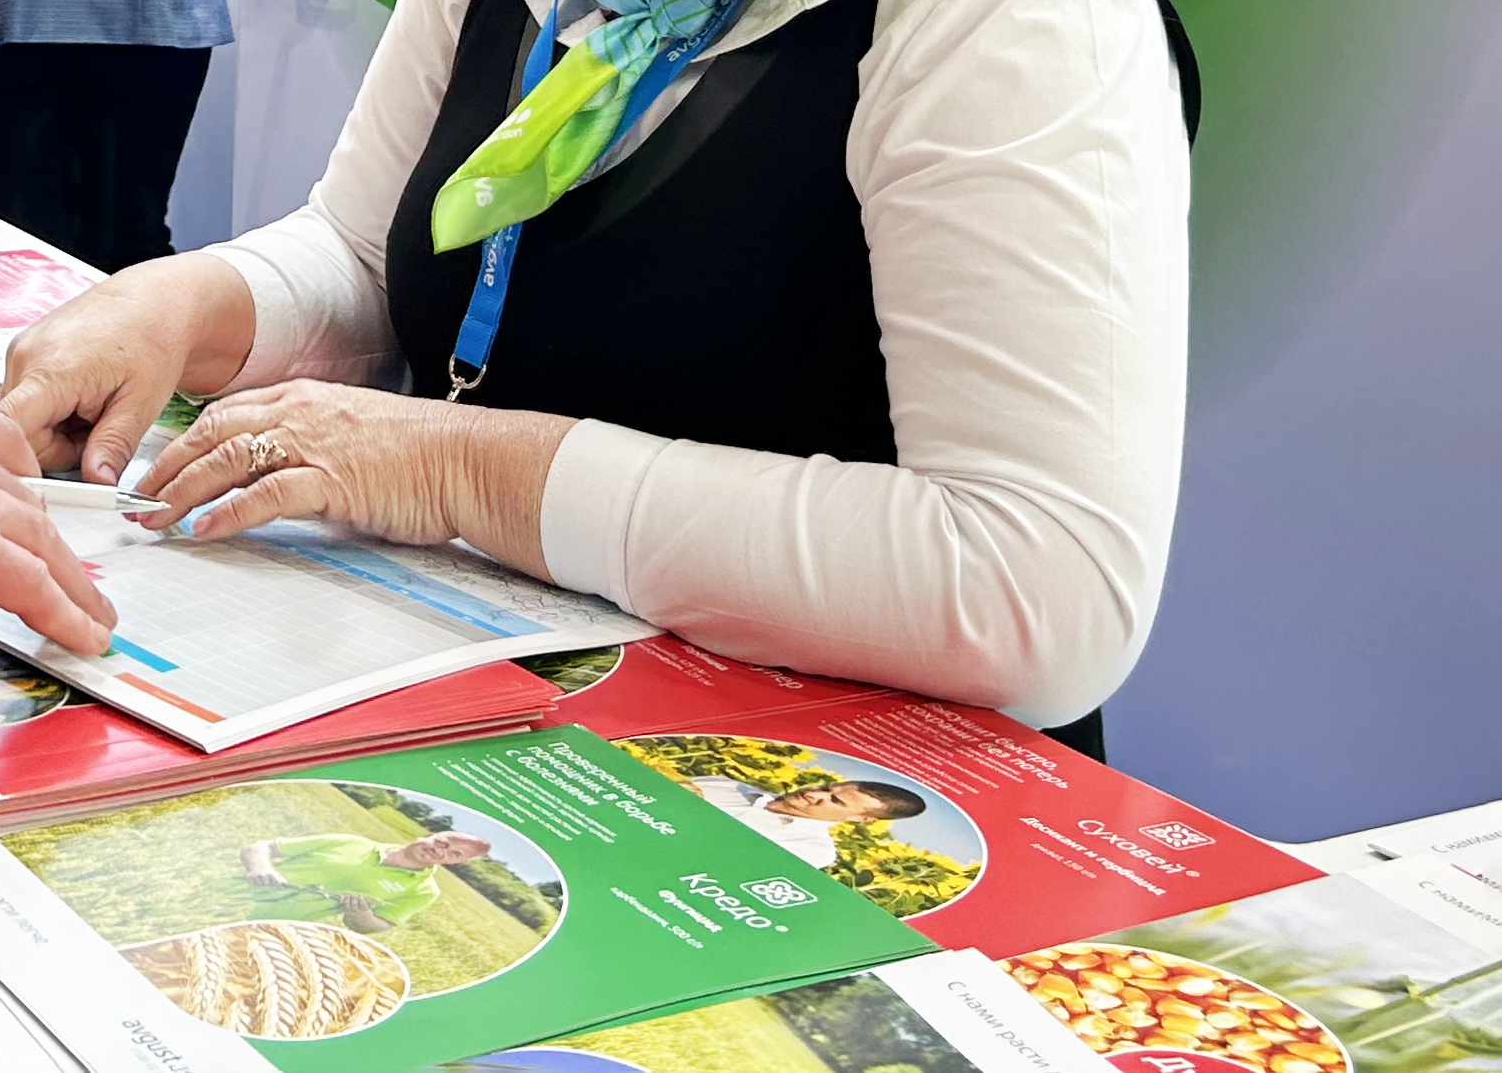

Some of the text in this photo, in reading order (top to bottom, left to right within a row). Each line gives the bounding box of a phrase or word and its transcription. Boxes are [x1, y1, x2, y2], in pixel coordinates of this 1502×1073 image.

[505, 749, 601, 806] с болезнями
[527, 745, 608, 794] помощник
[601, 793, 619, 802] в
[615, 800, 677, 836] борьбе
[548, 741, 658, 805] Проверенный
[977, 742, 1012, 760] без
[1009, 758, 1069, 790] потерь
[1019, 816, 1167, 896] Десикант и гербицид
[947, 980, 1051, 1069] С нами расти
